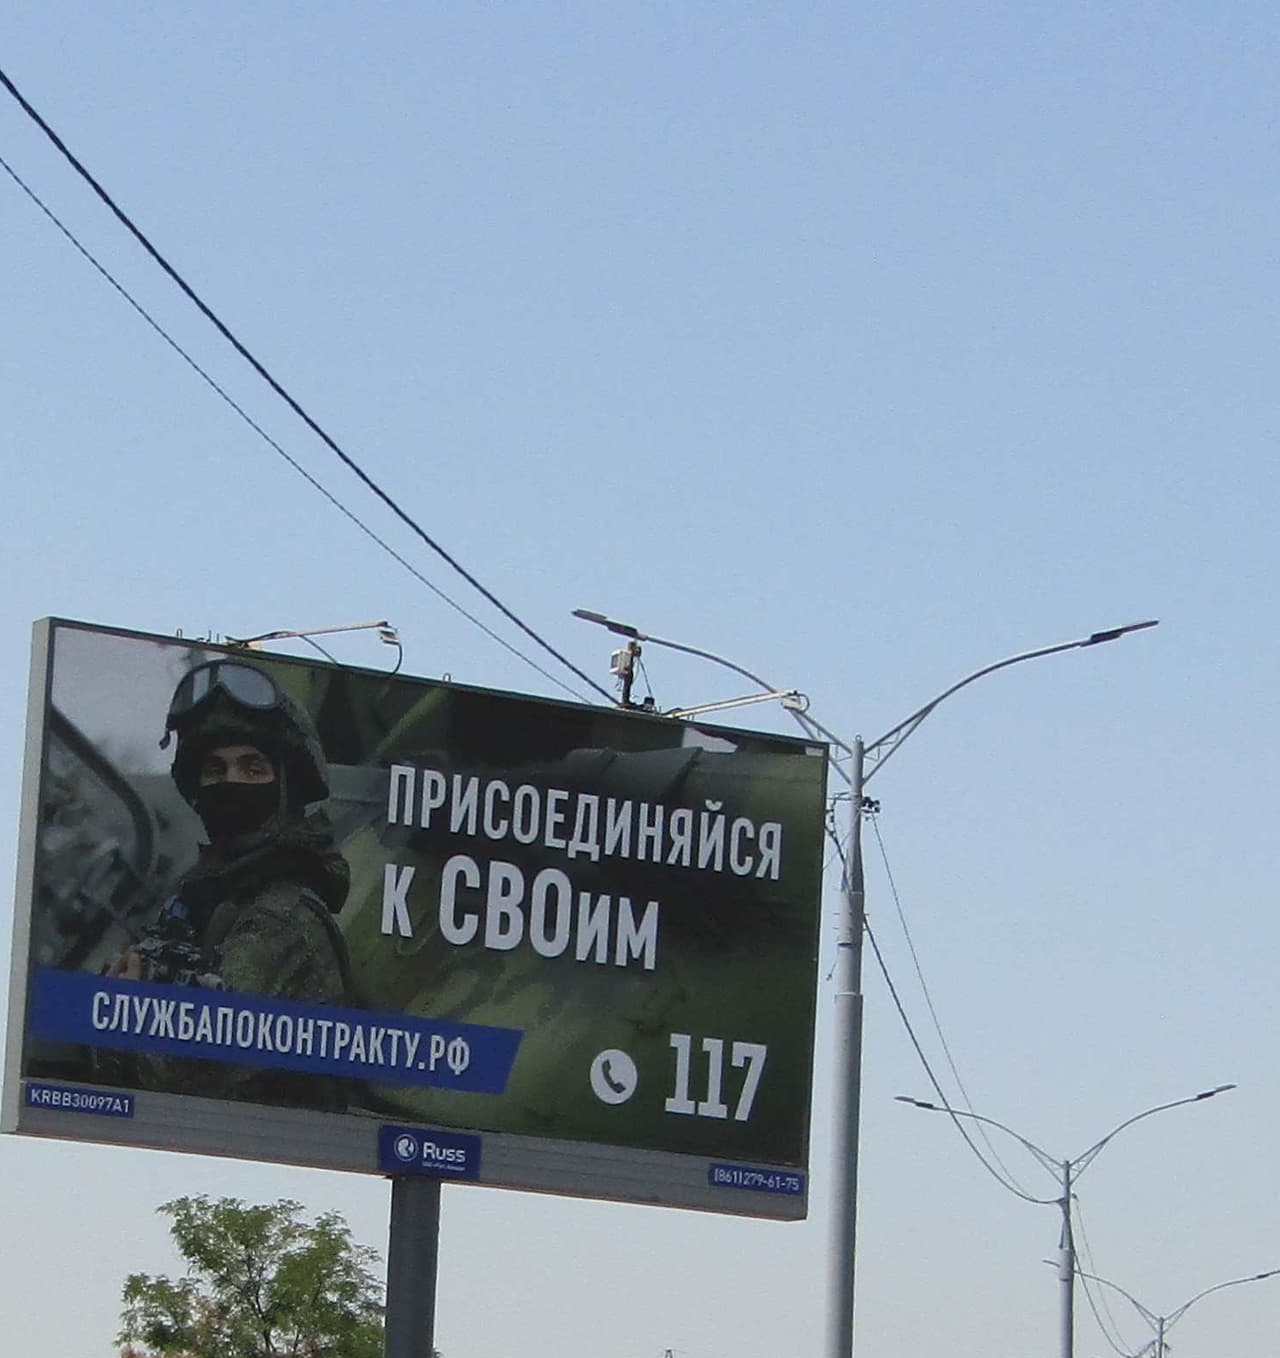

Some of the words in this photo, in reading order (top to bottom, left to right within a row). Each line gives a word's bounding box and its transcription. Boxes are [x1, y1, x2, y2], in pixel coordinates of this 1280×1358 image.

[387, 764, 782, 881] ПРИСОЕДИНЯЙСЯ
[91, 991, 470, 1076] СЛУЖБАПОКОНТРАКТУ.РФ
[31, 1088, 129, 1113] KRBB30097A1
[665, 1033, 767, 1121] 117
[423, 1142, 466, 1163] Russ
